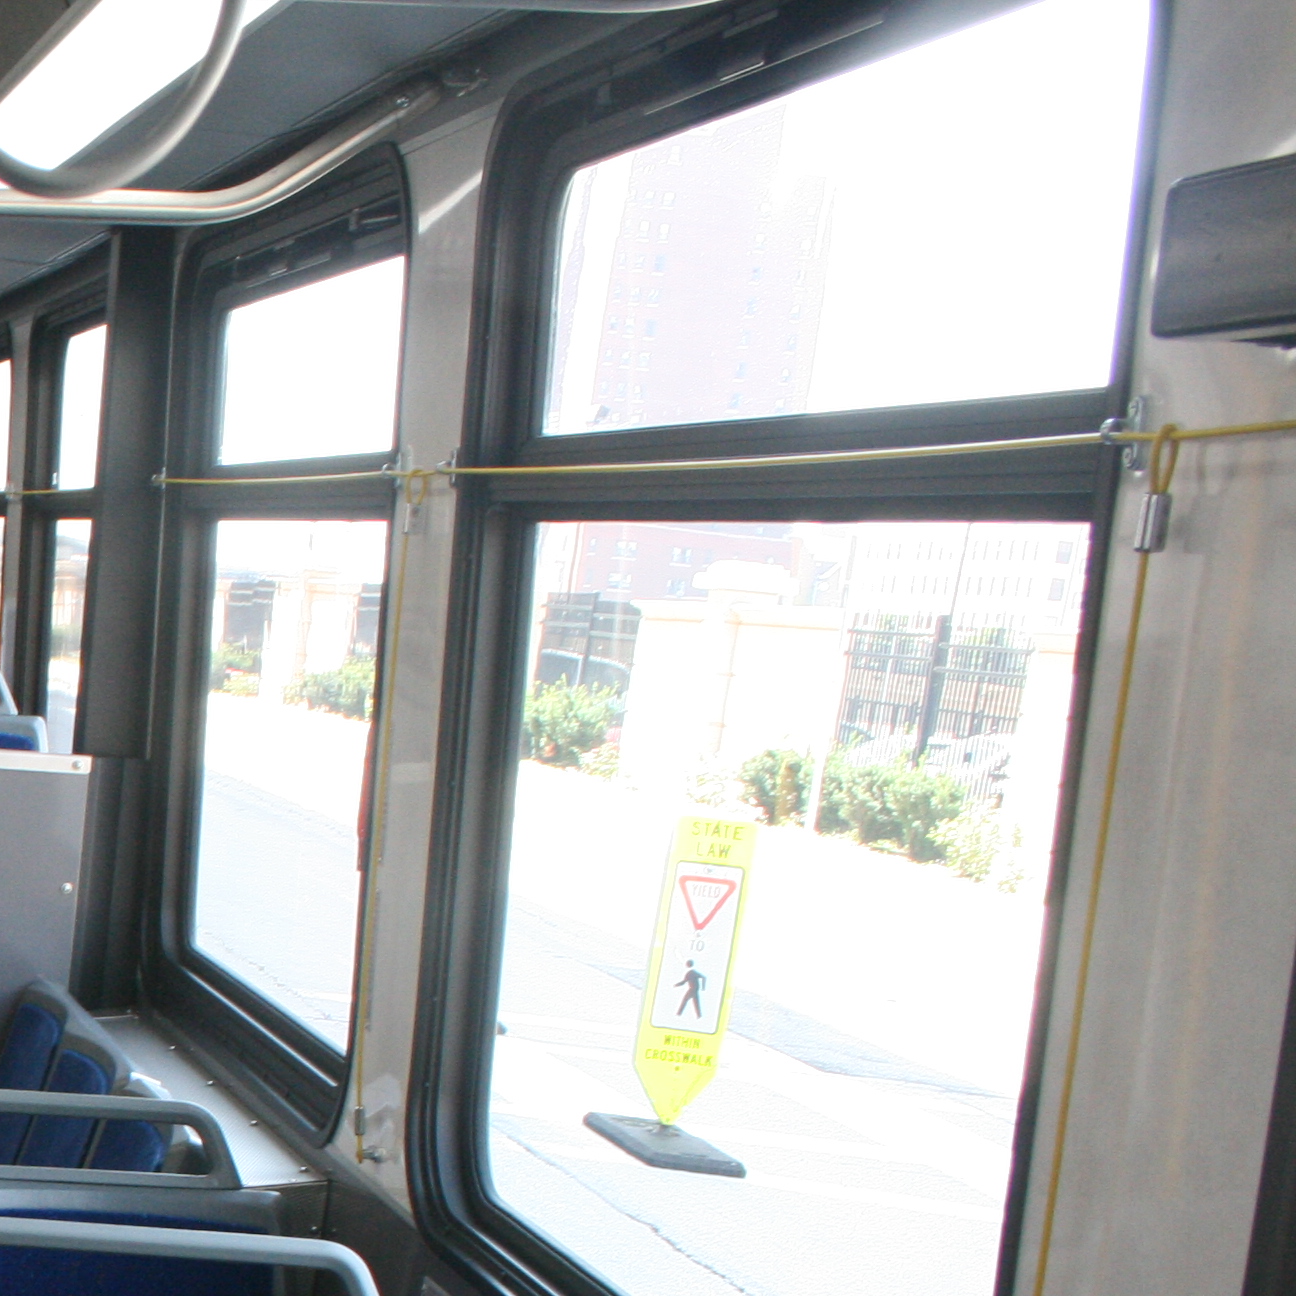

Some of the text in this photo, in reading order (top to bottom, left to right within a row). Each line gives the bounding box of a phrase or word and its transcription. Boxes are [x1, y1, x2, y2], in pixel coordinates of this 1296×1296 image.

[691, 820, 746, 841] STATE
[696, 841, 732, 859] LAW
[692, 883, 721, 899] YIELD
[689, 939, 705, 952] TO
[663, 1034, 701, 1050] WITHIN
[645, 1048, 714, 1068] CROSSWALK
